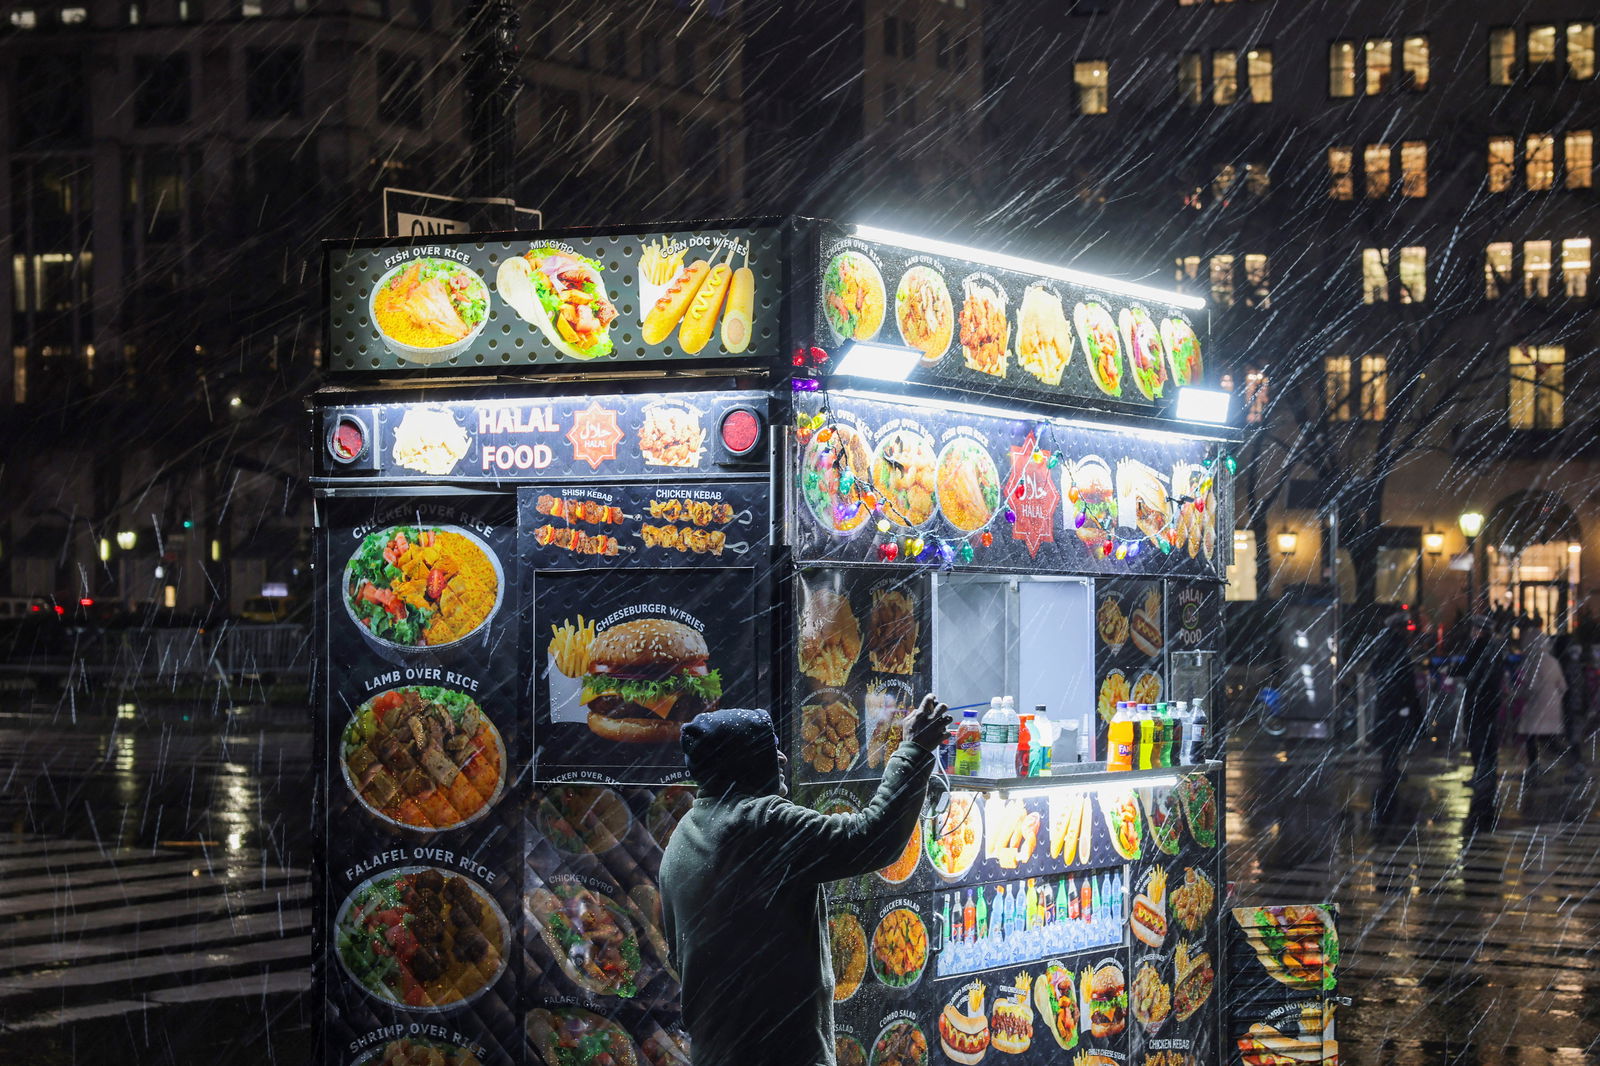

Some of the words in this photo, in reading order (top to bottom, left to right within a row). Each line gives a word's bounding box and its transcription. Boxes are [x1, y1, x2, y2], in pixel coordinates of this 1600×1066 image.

[530, 241, 547, 251] MIX
[550, 240, 574, 254] GYRO
[661, 240, 687, 258] CORN
[689, 236, 711, 247] DOG
[713, 237, 748, 257] W/FRIES
[853, 240, 869, 253] OVER
[384, 251, 410, 268] FISH
[413, 246, 441, 257] OVER
[445, 248, 471, 264] RICE
[478, 407, 560, 434] HALAL
[580, 420, 612, 440] حلال
[584, 440, 608, 449] HALAL
[482, 444, 553, 471] FOOD
[561, 489, 585, 498] SHISH
[587, 490, 613, 502] KEBAB
[655, 489, 691, 499] CHICKEN
[693, 490, 722, 500] KEBAB
[1022, 504, 1044, 518] HALAL
[352, 505, 414, 540] CHICKEN
[419, 504, 455, 519] OVER
[459, 512, 494, 538] RICE
[596, 603, 667, 633] CHEESEBURGER
[669, 606, 706, 633] W/FRIES
[1179, 628, 1202, 646] FOOD
[365, 671, 401, 691] LAMB
[405, 668, 441, 681] OVER
[446, 671, 480, 692] RICE
[581, 770, 603, 781] OVER
[660, 772, 683, 784] LAMB
[345, 849, 408, 881] FALAFEL
[413, 848, 454, 864] OVER
[459, 856, 497, 885] RICE
[549, 873, 587, 884] CHICKEN
[589, 875, 614, 894] GYRO
[880, 899, 902, 918] CHICKEN
[903, 898, 920, 912] SALAD
[544, 995, 580, 1006] FALAFEL
[583, 998, 607, 1016] GYRO
[880, 1011, 899, 1028] COMBO
[899, 1009, 917, 1020] SALAD
[835, 1024, 854, 1034] SALAD
[349, 1024, 404, 1054] SHRIMP
[410, 1023, 448, 1039] OVER
[452, 1032, 487, 1058] RICE
[1149, 1039, 1172, 1049] CHICKEN
[1172, 1039, 1190, 1049] KEBAB
